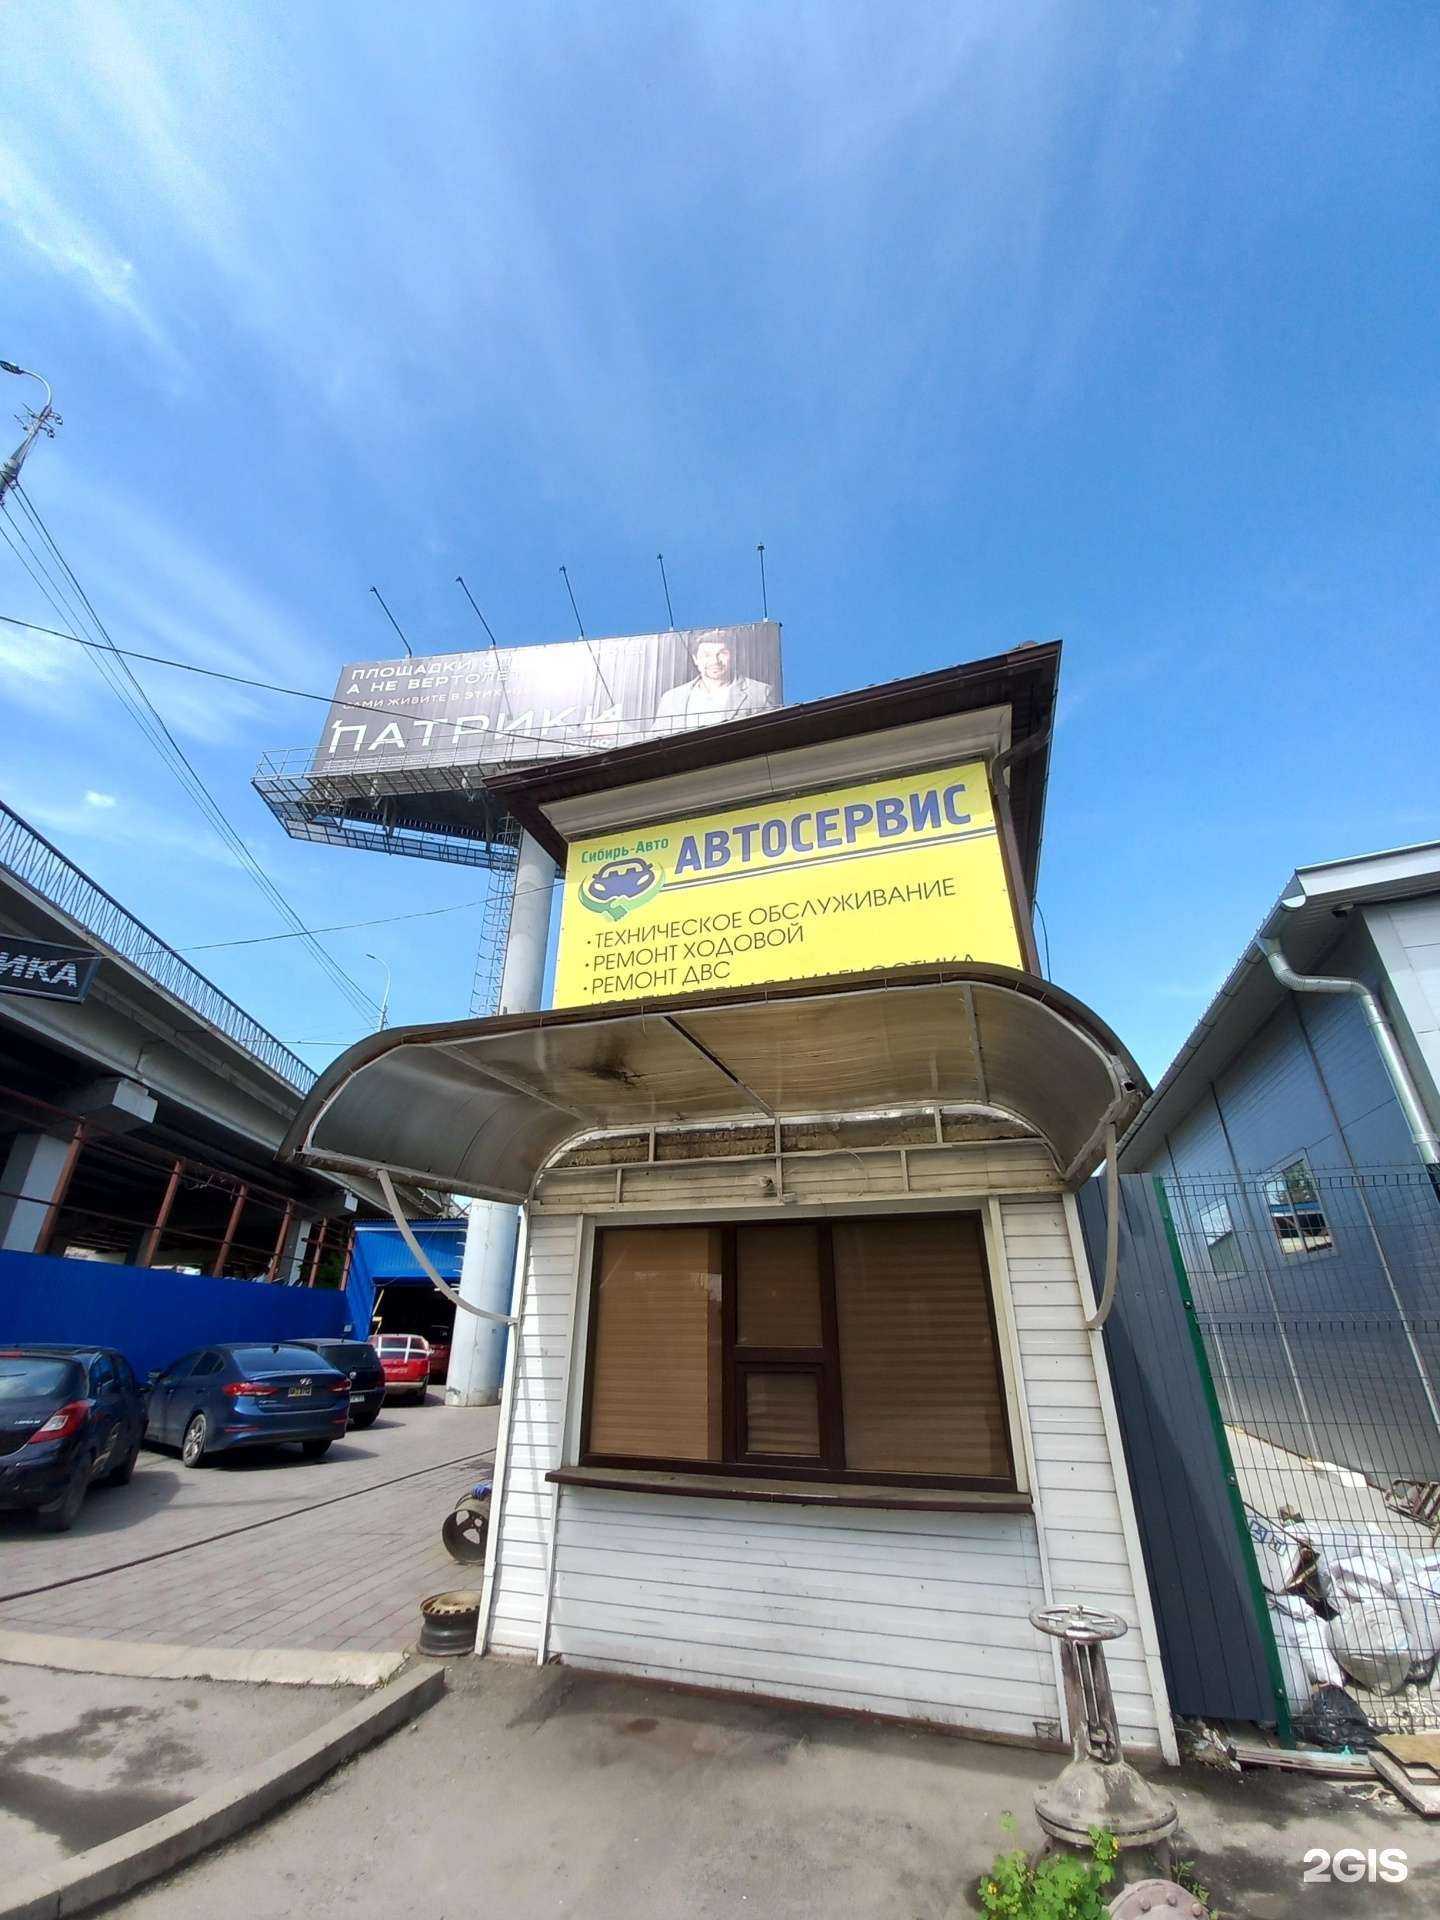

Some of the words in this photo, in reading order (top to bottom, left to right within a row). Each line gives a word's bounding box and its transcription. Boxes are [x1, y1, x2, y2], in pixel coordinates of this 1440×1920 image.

[351, 659, 472, 681] ПЛОЩАДКИ
[346, 683, 360, 695] А
[370, 680, 398, 693] НЕ
[387, 694, 445, 706] ЖИВИТЕ
[674, 783, 971, 874] АВТОСЕРВИС
[581, 838, 669, 863] Сибирь-Авто
[595, 911, 742, 948] ТЕХНИЧЕСКОЕ
[748, 877, 956, 925] ОБСЛУЖИВАНИЕ
[593, 944, 678, 972] РЕМОНТ
[683, 922, 804, 960] ХОДОВОЙ
[592, 967, 678, 995] РЕМОНТ
[681, 961, 731, 986] ДВС
